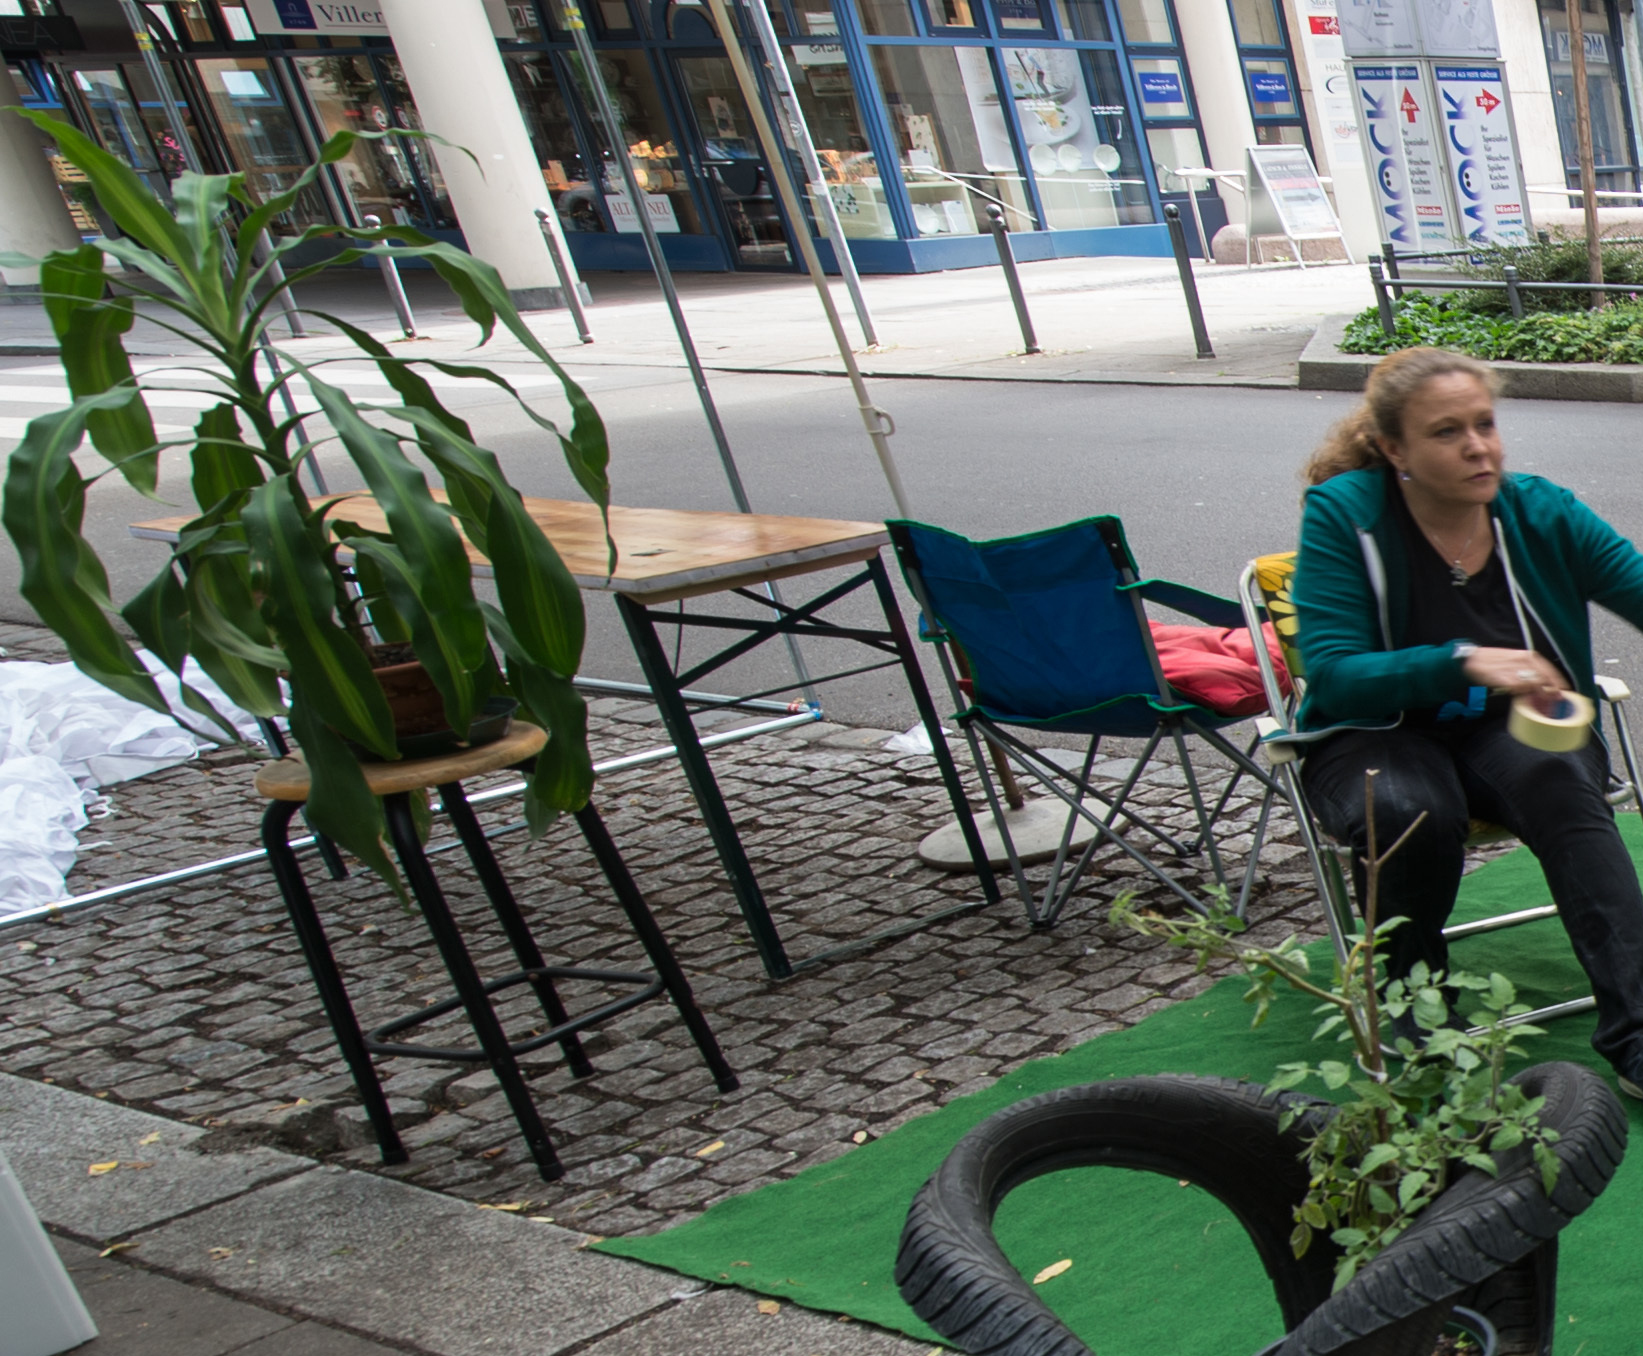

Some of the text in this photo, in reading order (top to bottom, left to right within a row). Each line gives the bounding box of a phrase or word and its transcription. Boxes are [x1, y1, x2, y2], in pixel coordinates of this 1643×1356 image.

[1480, 125, 1488, 133] Ihr
[1482, 134, 1508, 143] Spezialist
[1484, 144, 1492, 152] für
[1485, 154, 1510, 162] Waschen
[1361, 86, 1412, 245] MÖCK
[1442, 88, 1491, 244] MÖCK
[1487, 163, 1506, 172] Spülen
[1489, 173, 1509, 181] Kochen
[612, 201, 671, 216] ALT NEU
[1417, 207, 1442, 215] Miele
[1495, 204, 1521, 213] Miele
